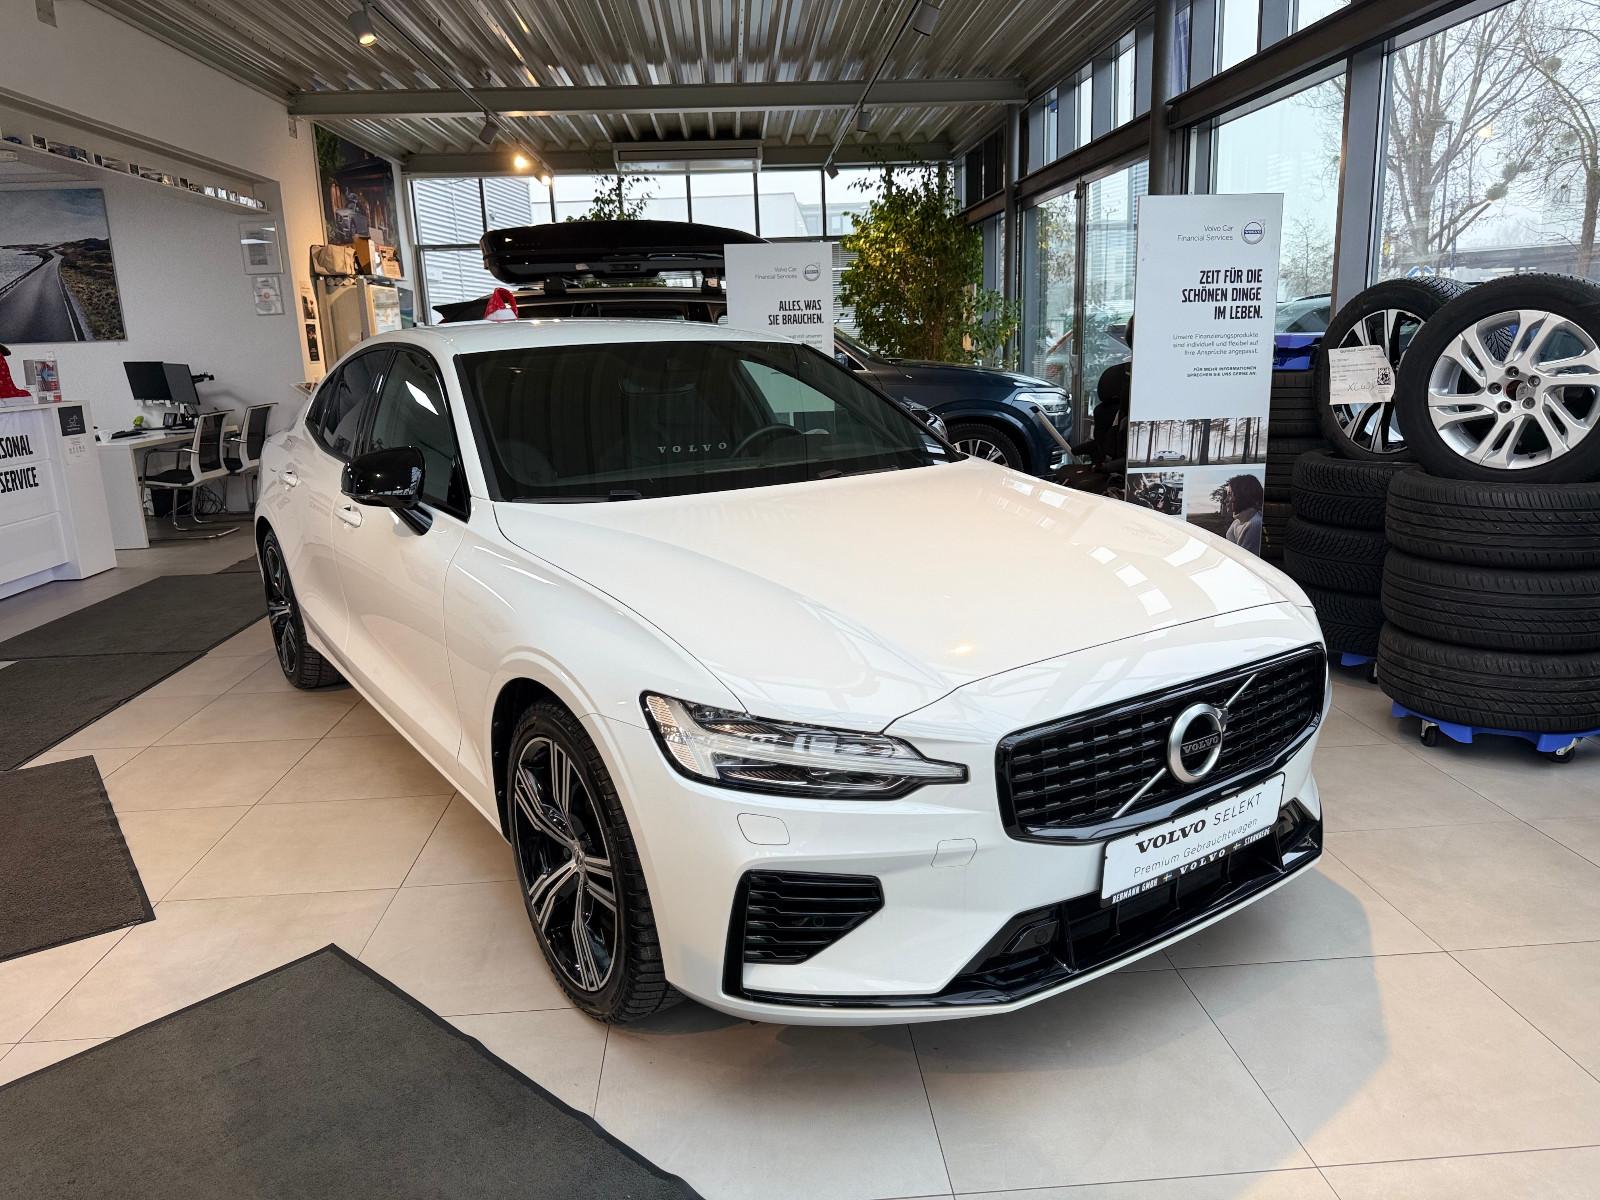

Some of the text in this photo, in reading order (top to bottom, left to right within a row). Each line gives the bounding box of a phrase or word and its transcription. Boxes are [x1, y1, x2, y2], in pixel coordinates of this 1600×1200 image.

[1204, 224, 1234, 232] Volvo Car
[1177, 233, 1233, 242] Financial Services
[1200, 267, 1263, 285] ZEIT FÜR DIE
[1182, 286, 1262, 303] SCHÖNEN DINGE
[779, 300, 822, 311] ALLES, WAS
[1214, 305, 1263, 320] IM LEBEN.
[768, 313, 824, 325] SIE BRAUCHEN.
[0, 434, 33, 460] SONAL
[657, 442, 727, 454] VOLVO
[0, 467, 39, 494] SERVICE
[1183, 736, 1219, 754] VOLVO
[1135, 792, 1262, 854] VOLVO SELEKT
[1133, 817, 1258, 878] Premium Gebrauchtwagen
[1141, 878, 1158, 894] GMBH
[1179, 849, 1226, 875] VOLVO
